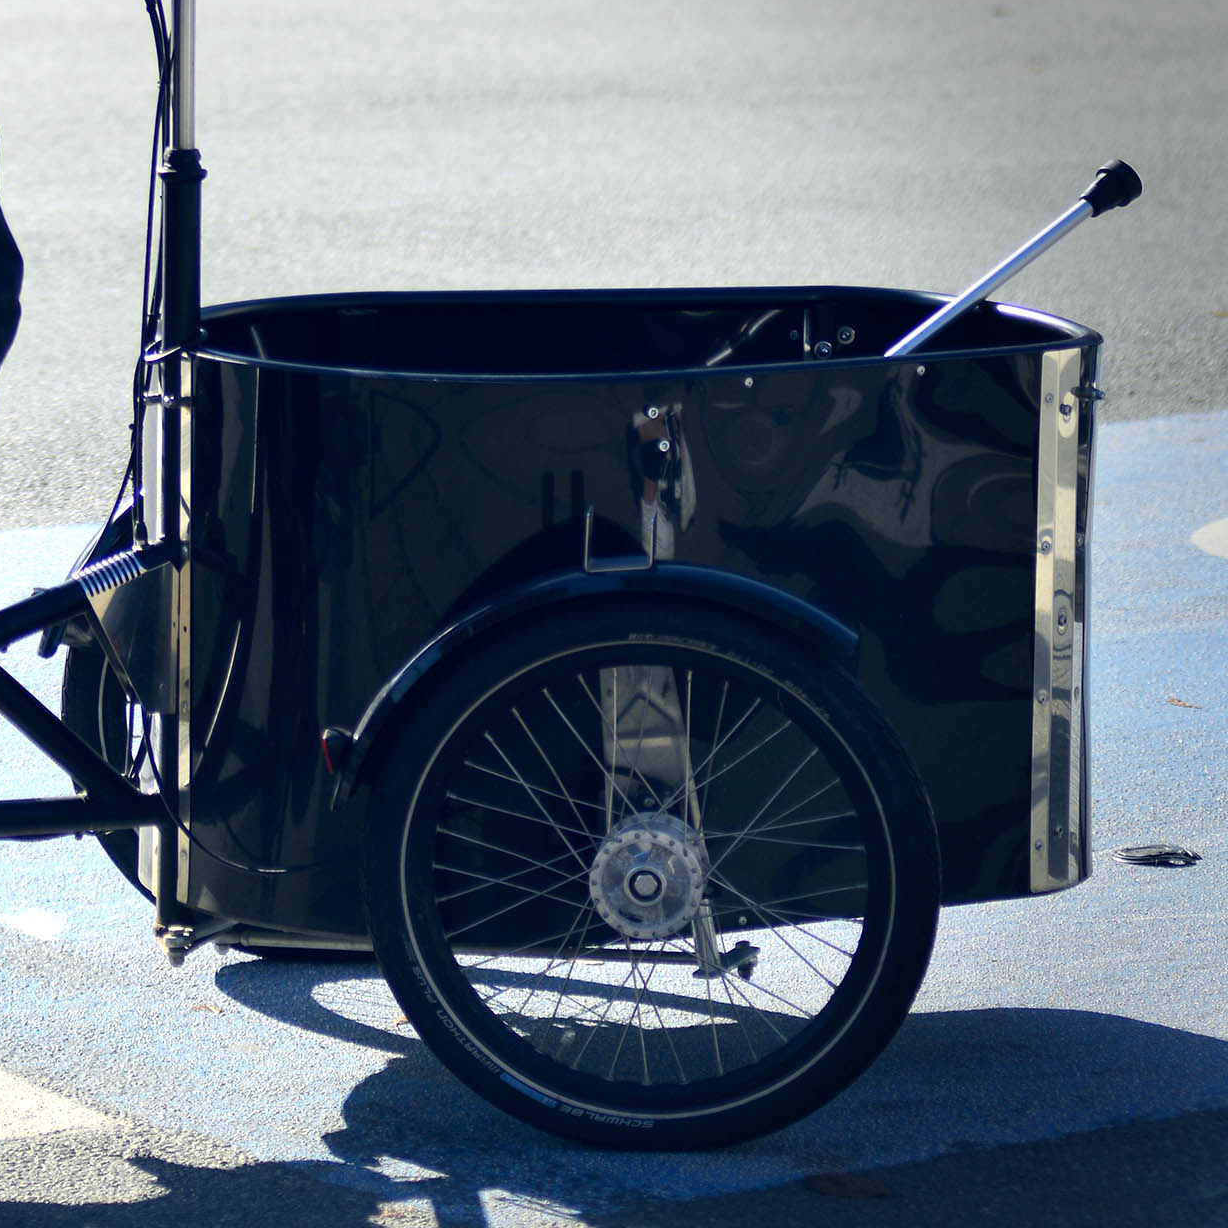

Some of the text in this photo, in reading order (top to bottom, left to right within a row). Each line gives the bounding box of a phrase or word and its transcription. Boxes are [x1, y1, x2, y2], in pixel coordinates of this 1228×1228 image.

[411, 965, 656, 1130] SCHWALBE MARATHON PLUS
